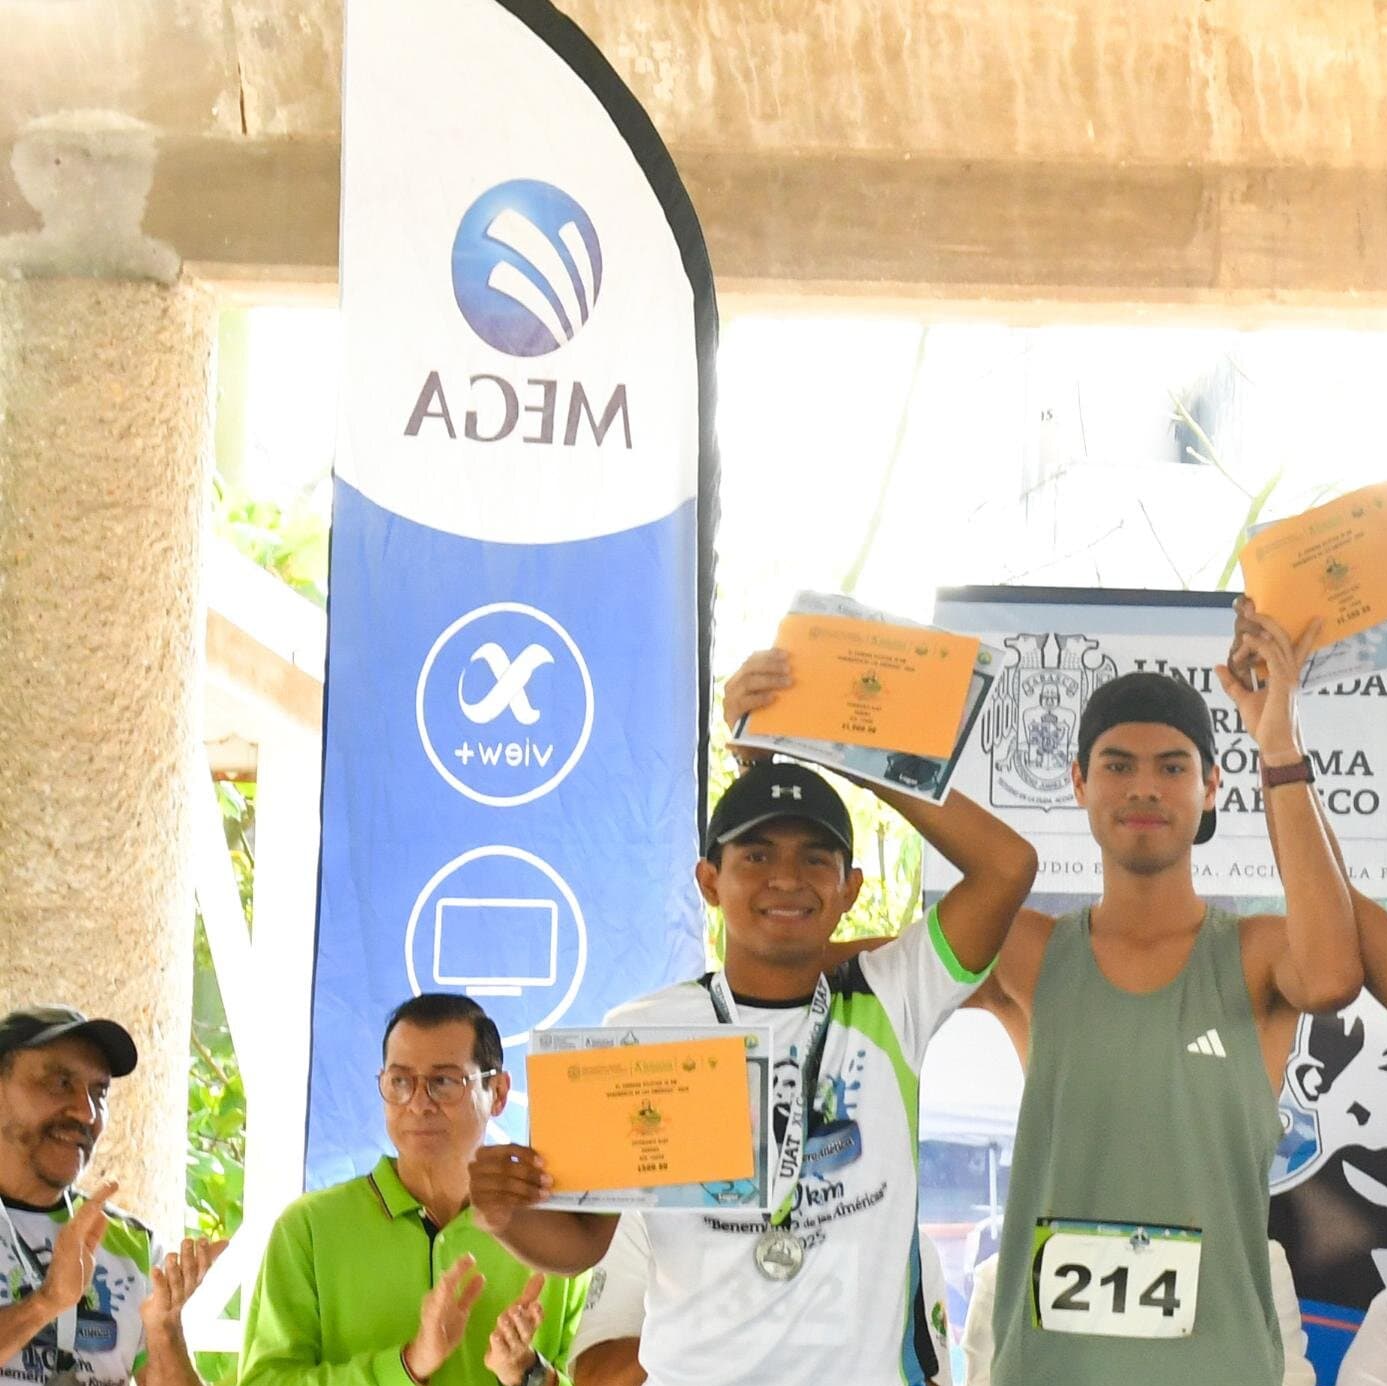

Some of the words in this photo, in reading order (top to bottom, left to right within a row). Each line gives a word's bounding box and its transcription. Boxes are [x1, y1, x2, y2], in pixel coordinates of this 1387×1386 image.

[811, 977, 829, 1014] UJAT
[779, 1134, 801, 1179] UJAT
[1051, 1263, 1181, 1318] 214
